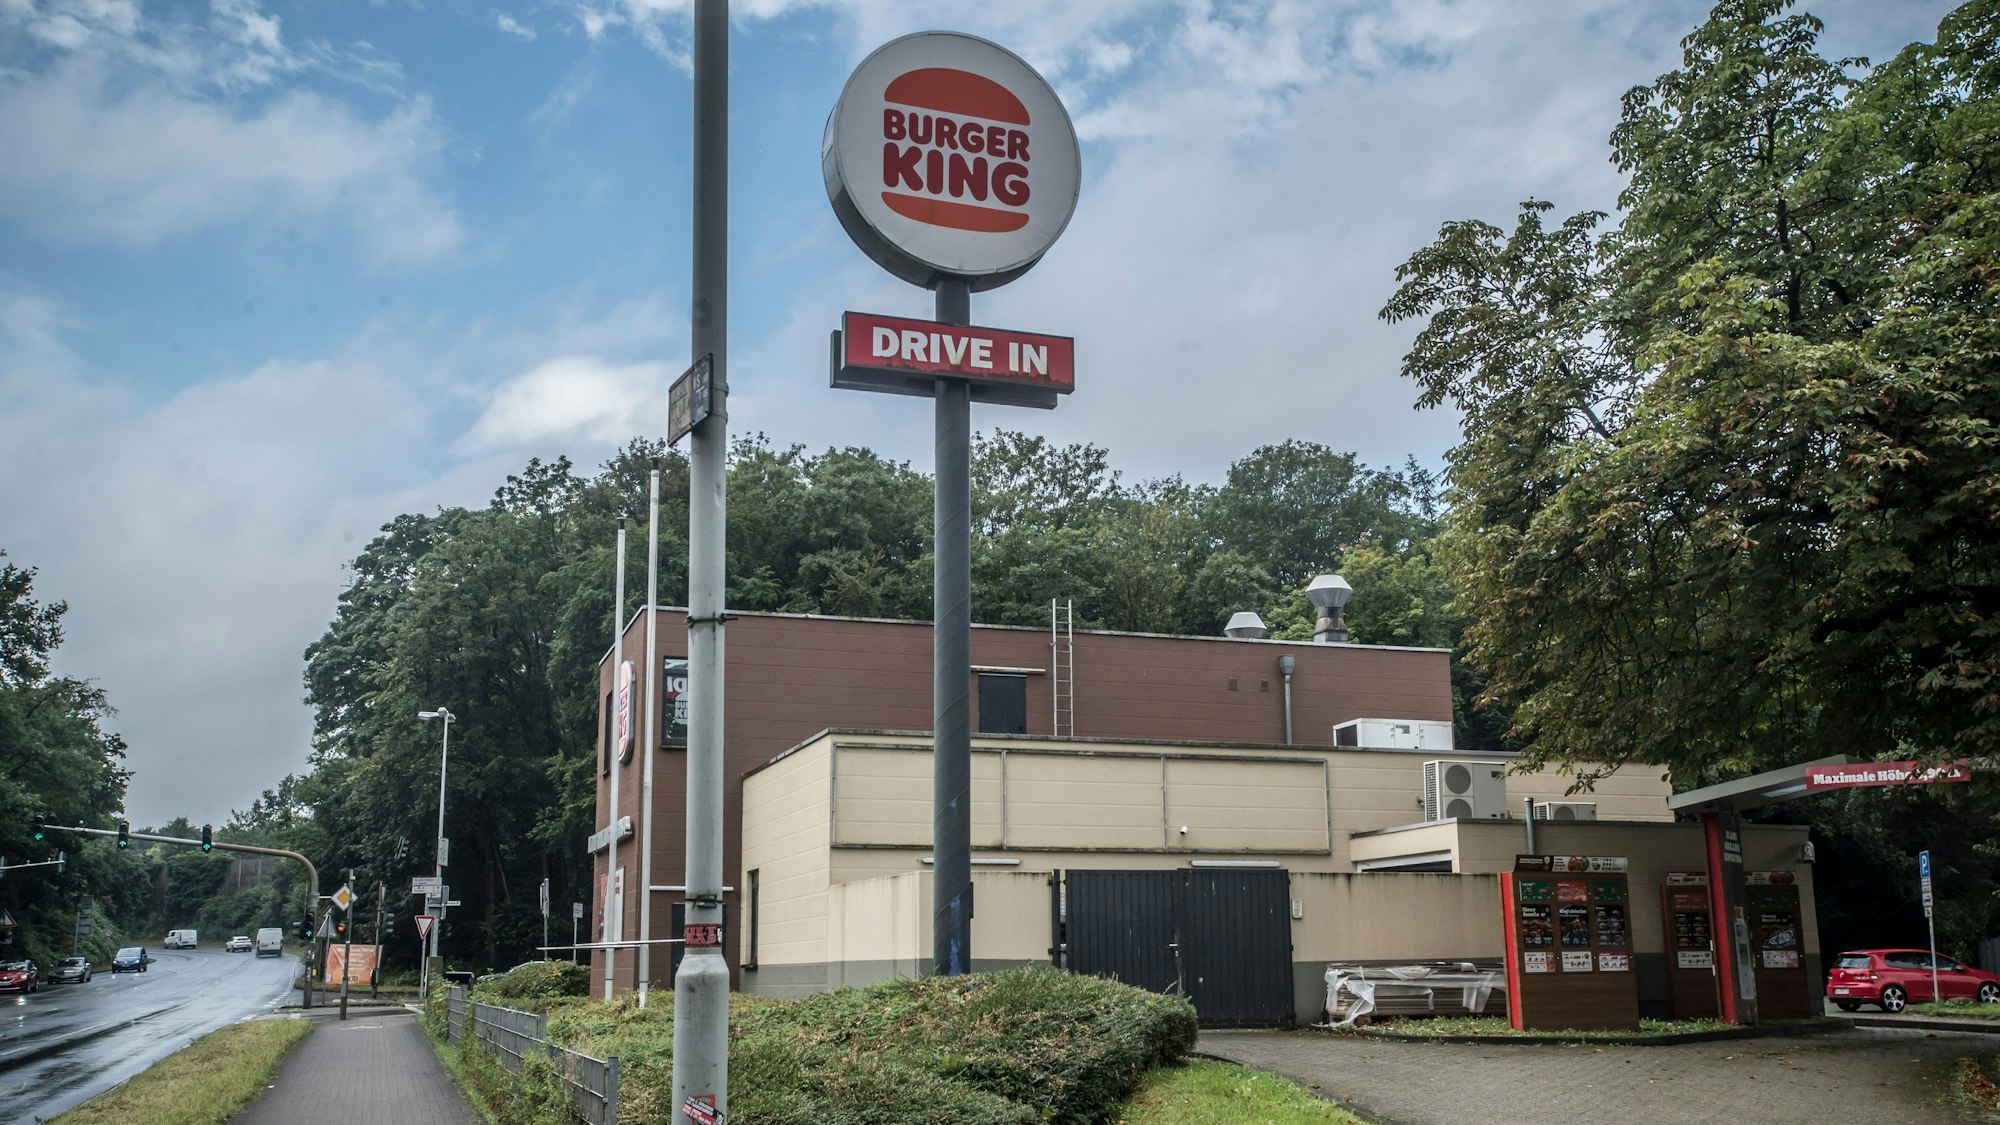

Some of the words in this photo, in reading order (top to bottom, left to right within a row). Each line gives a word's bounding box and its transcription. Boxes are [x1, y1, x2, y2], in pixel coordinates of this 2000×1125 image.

[884, 109, 1030, 162] BURGER
[883, 142, 1030, 207] KING
[872, 326, 993, 369] DRIVE
[1009, 342, 1048, 375] IN
[1813, 771, 1876, 785] Maximale
